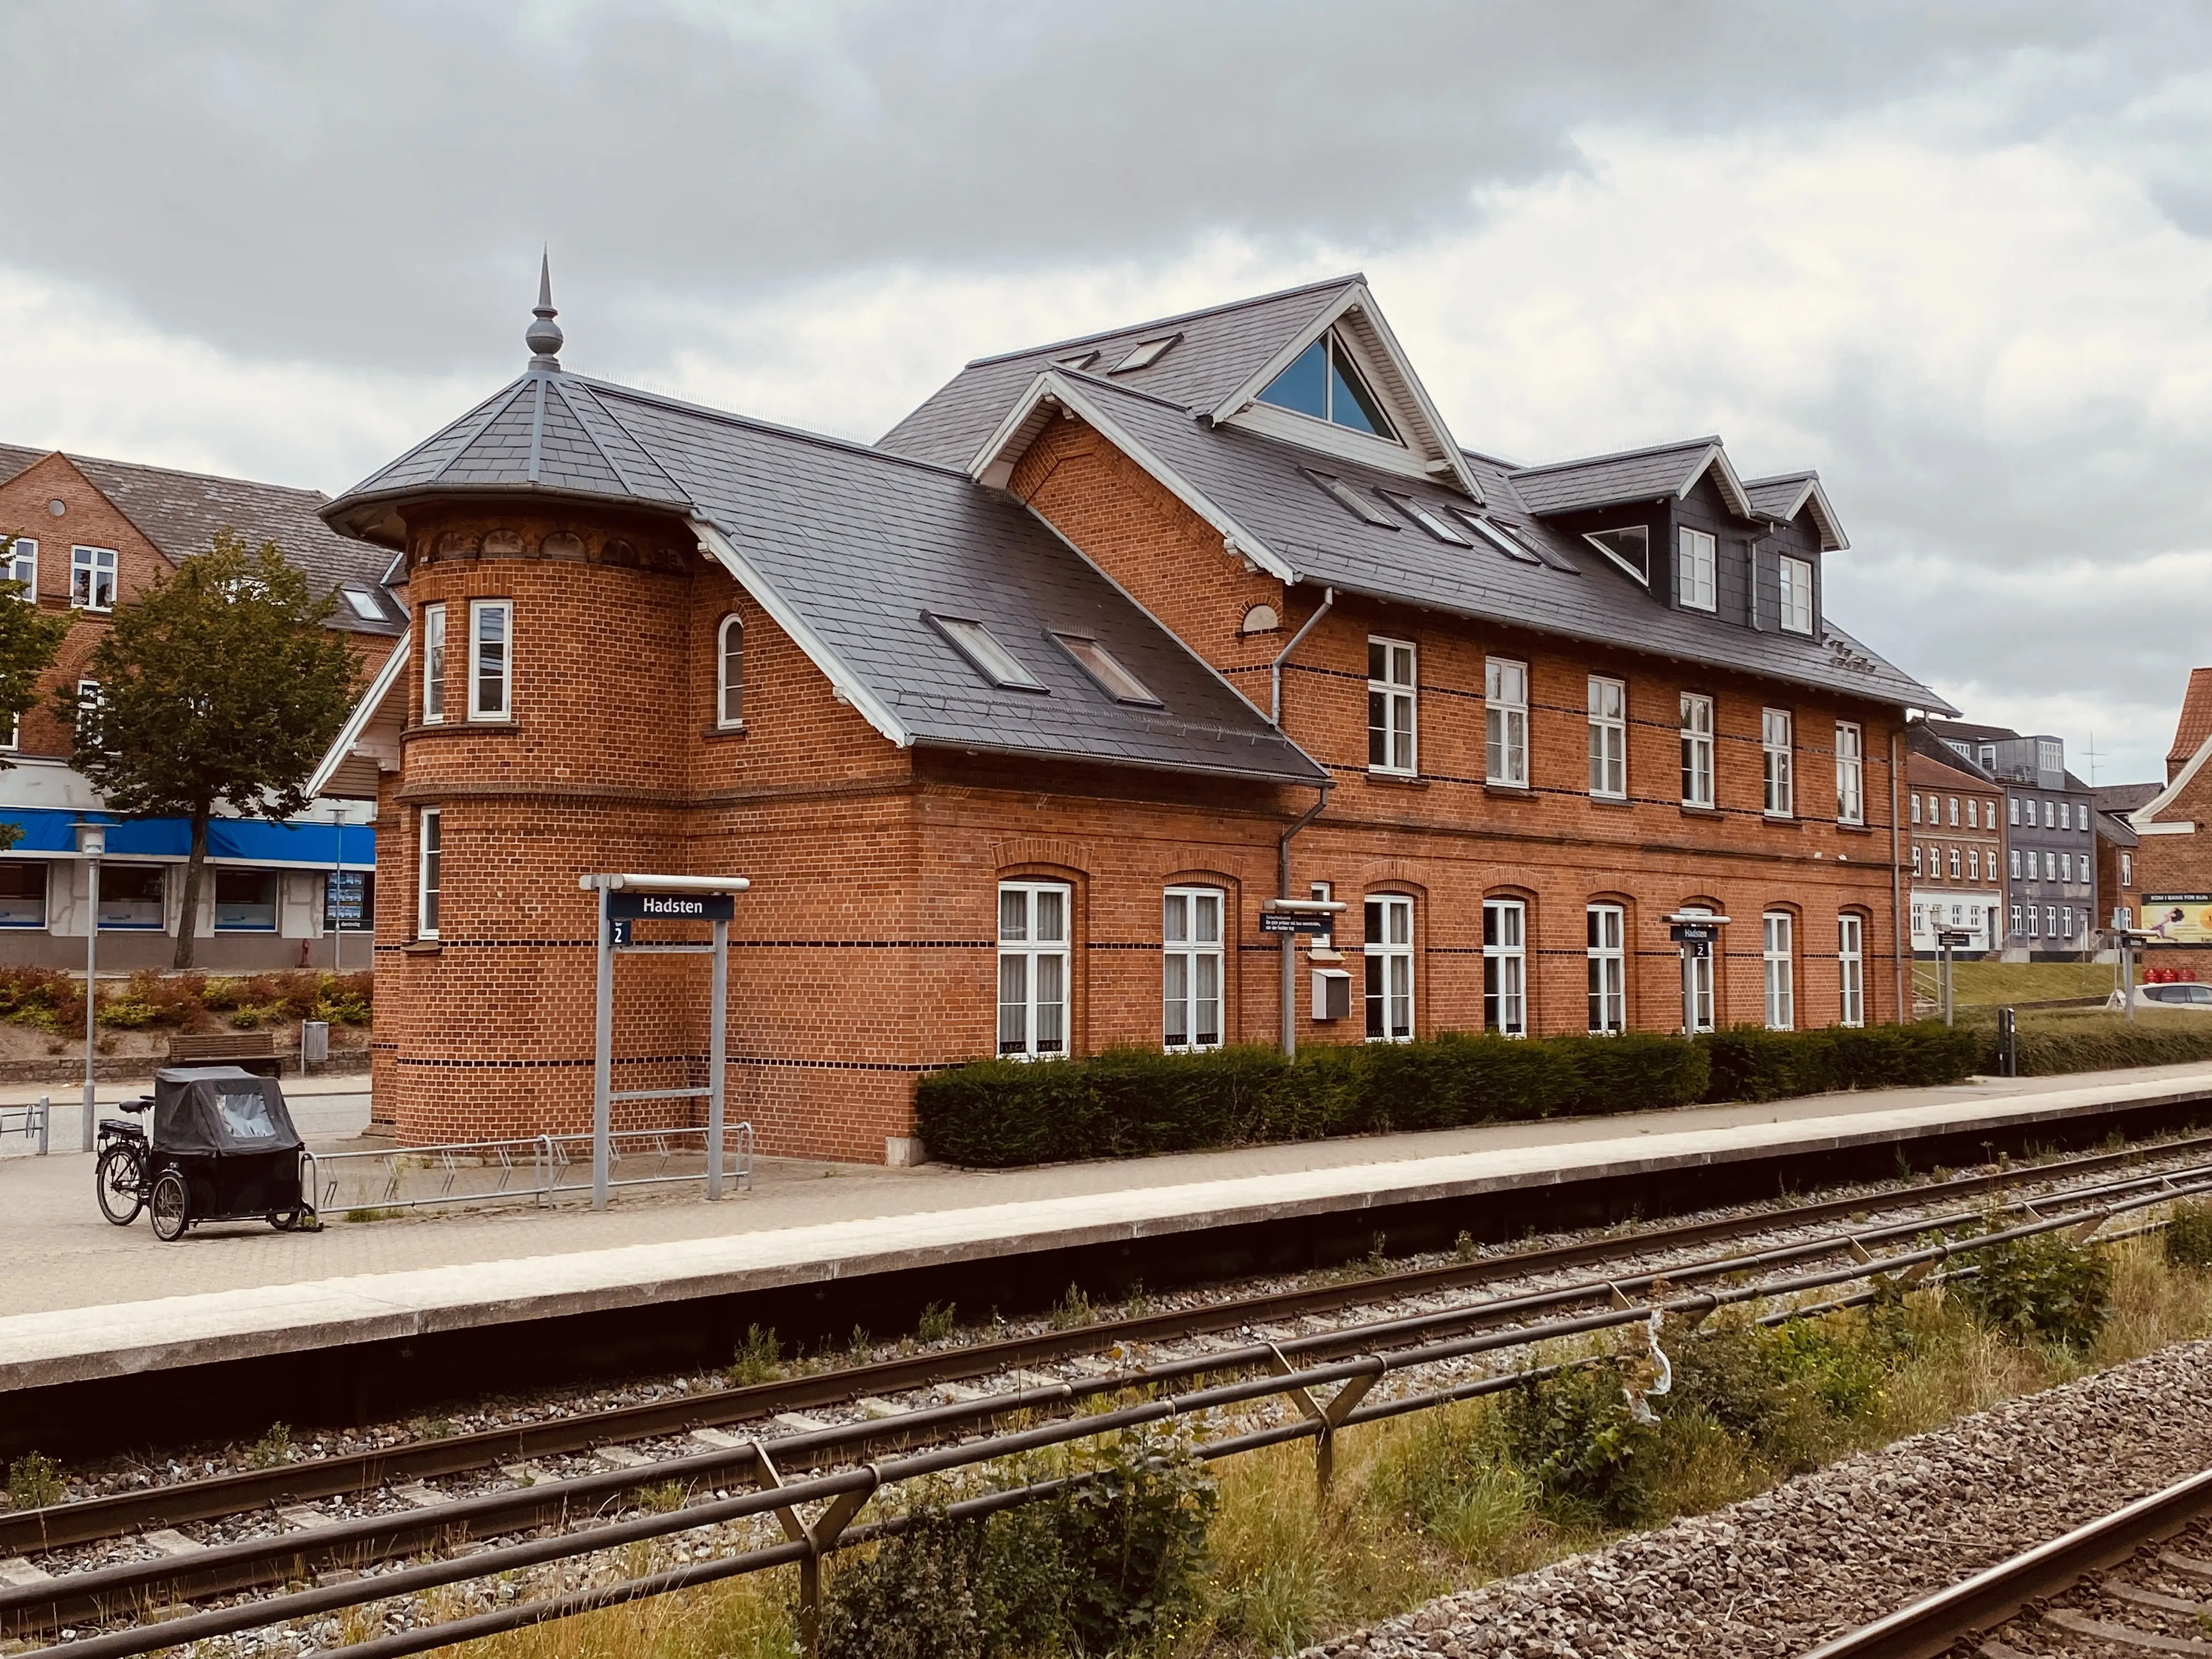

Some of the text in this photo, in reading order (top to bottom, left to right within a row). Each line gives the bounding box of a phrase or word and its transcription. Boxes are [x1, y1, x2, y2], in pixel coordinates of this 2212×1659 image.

[643, 898, 703, 913] Hadsten
[614, 928, 622, 943] 2
[1684, 928, 1707, 938] Hadsten
[1697, 946, 1704, 956] 2
